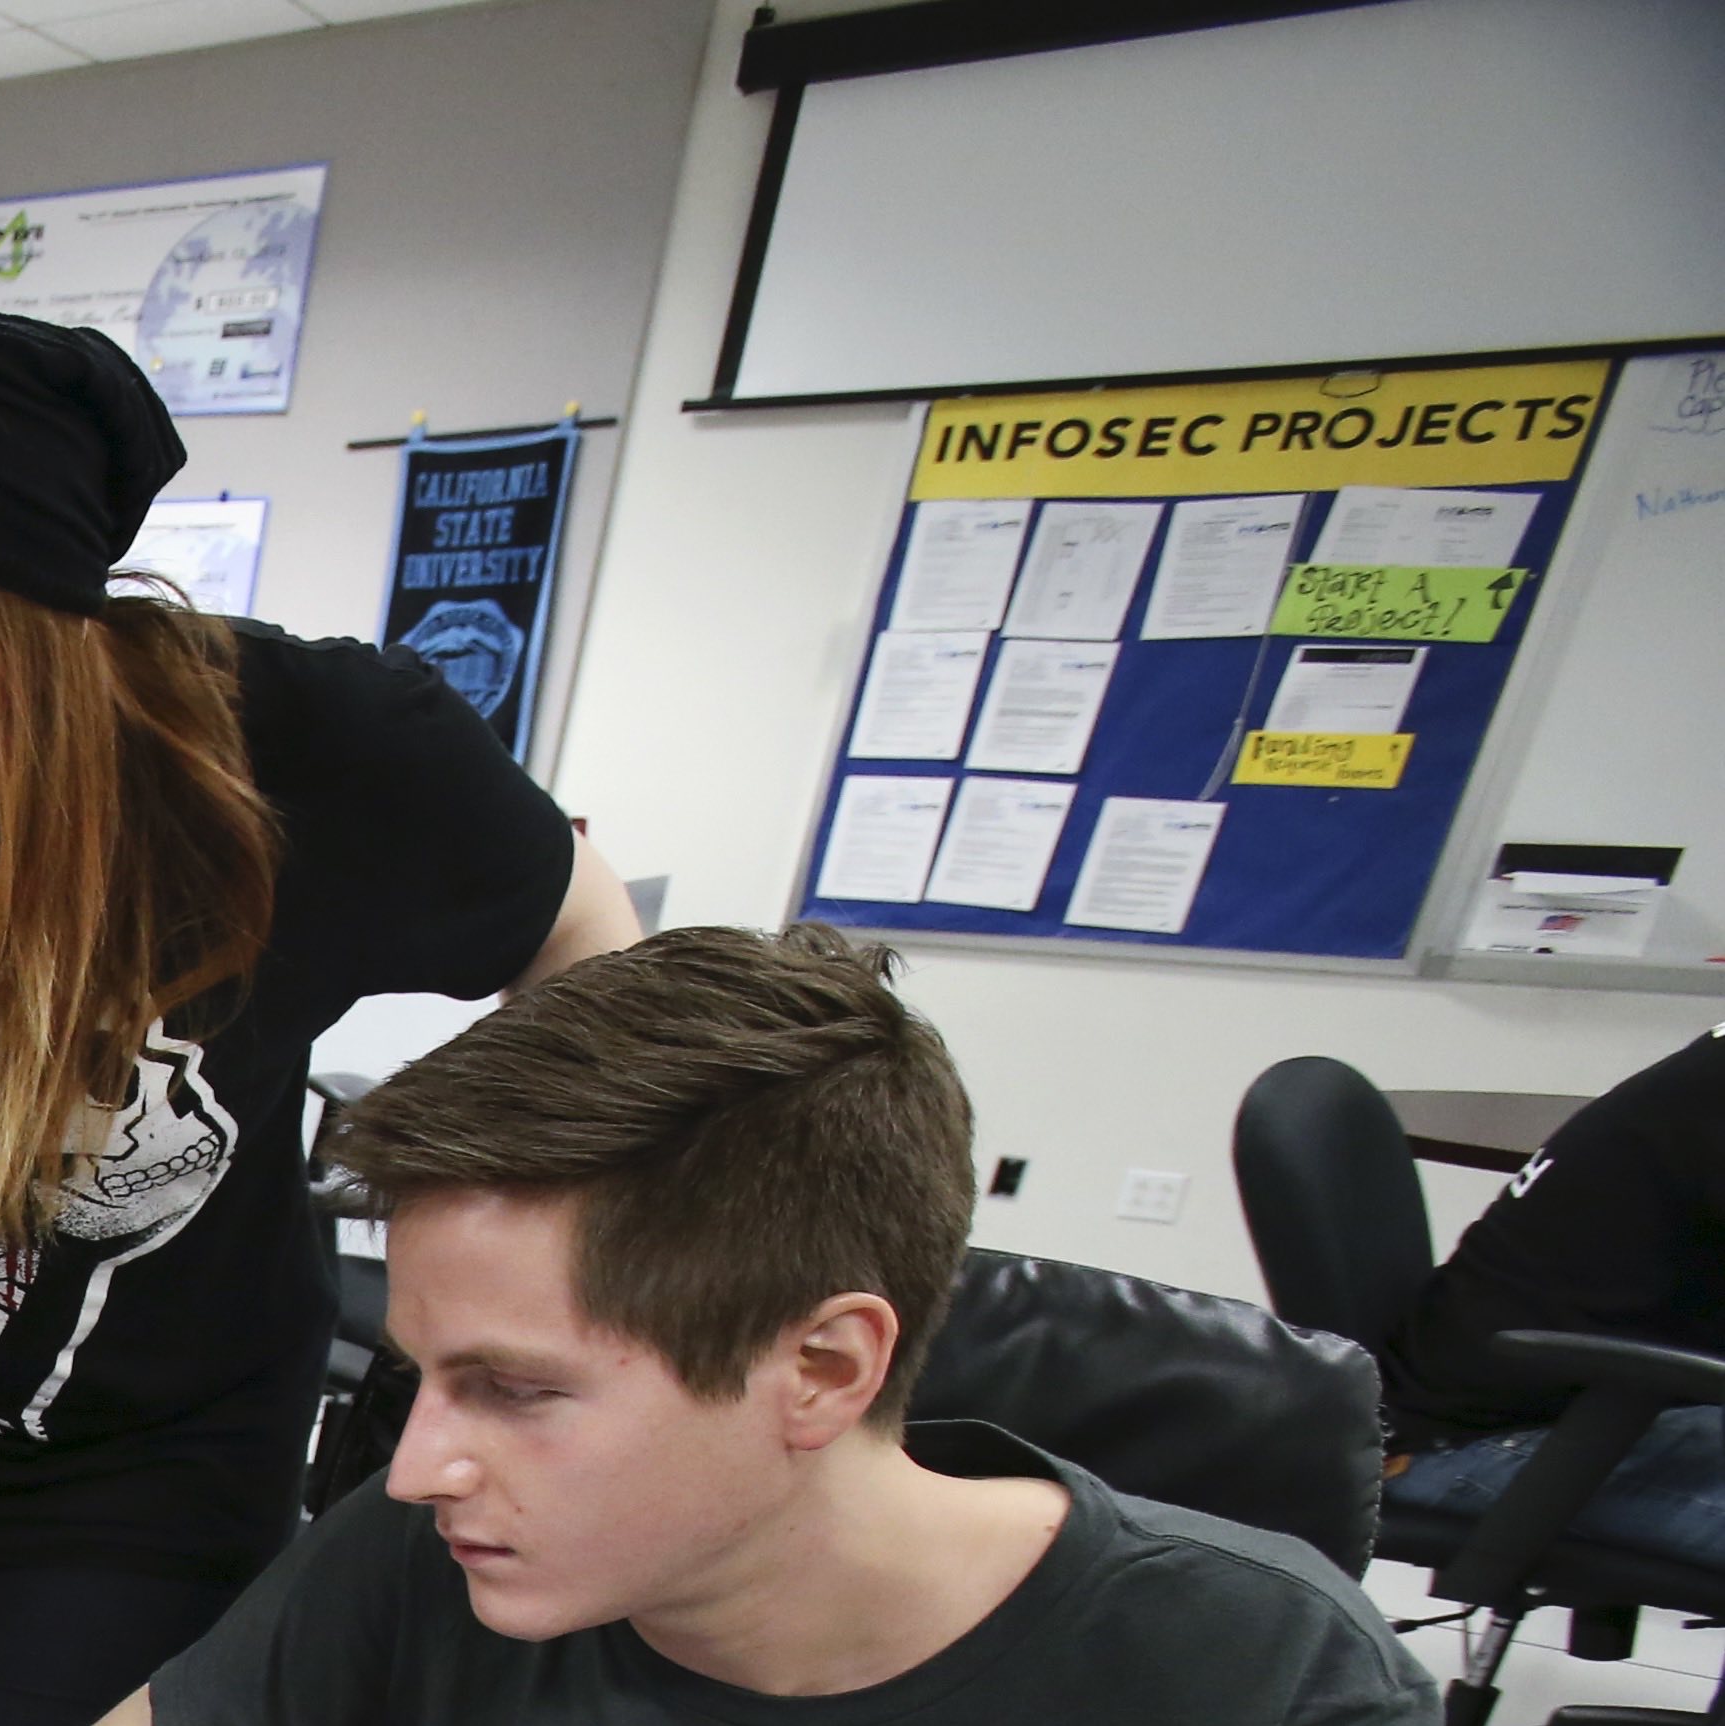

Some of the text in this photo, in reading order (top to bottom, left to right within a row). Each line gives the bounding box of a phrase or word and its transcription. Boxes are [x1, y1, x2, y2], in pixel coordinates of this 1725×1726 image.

[935, 394, 1595, 463] INFOSEC PROJECTS
[414, 461, 550, 509] CALIFORNIA
[433, 506, 516, 548] STATE
[402, 545, 545, 590] UNIVERSITY
[1411, 572, 1432, 603] A
